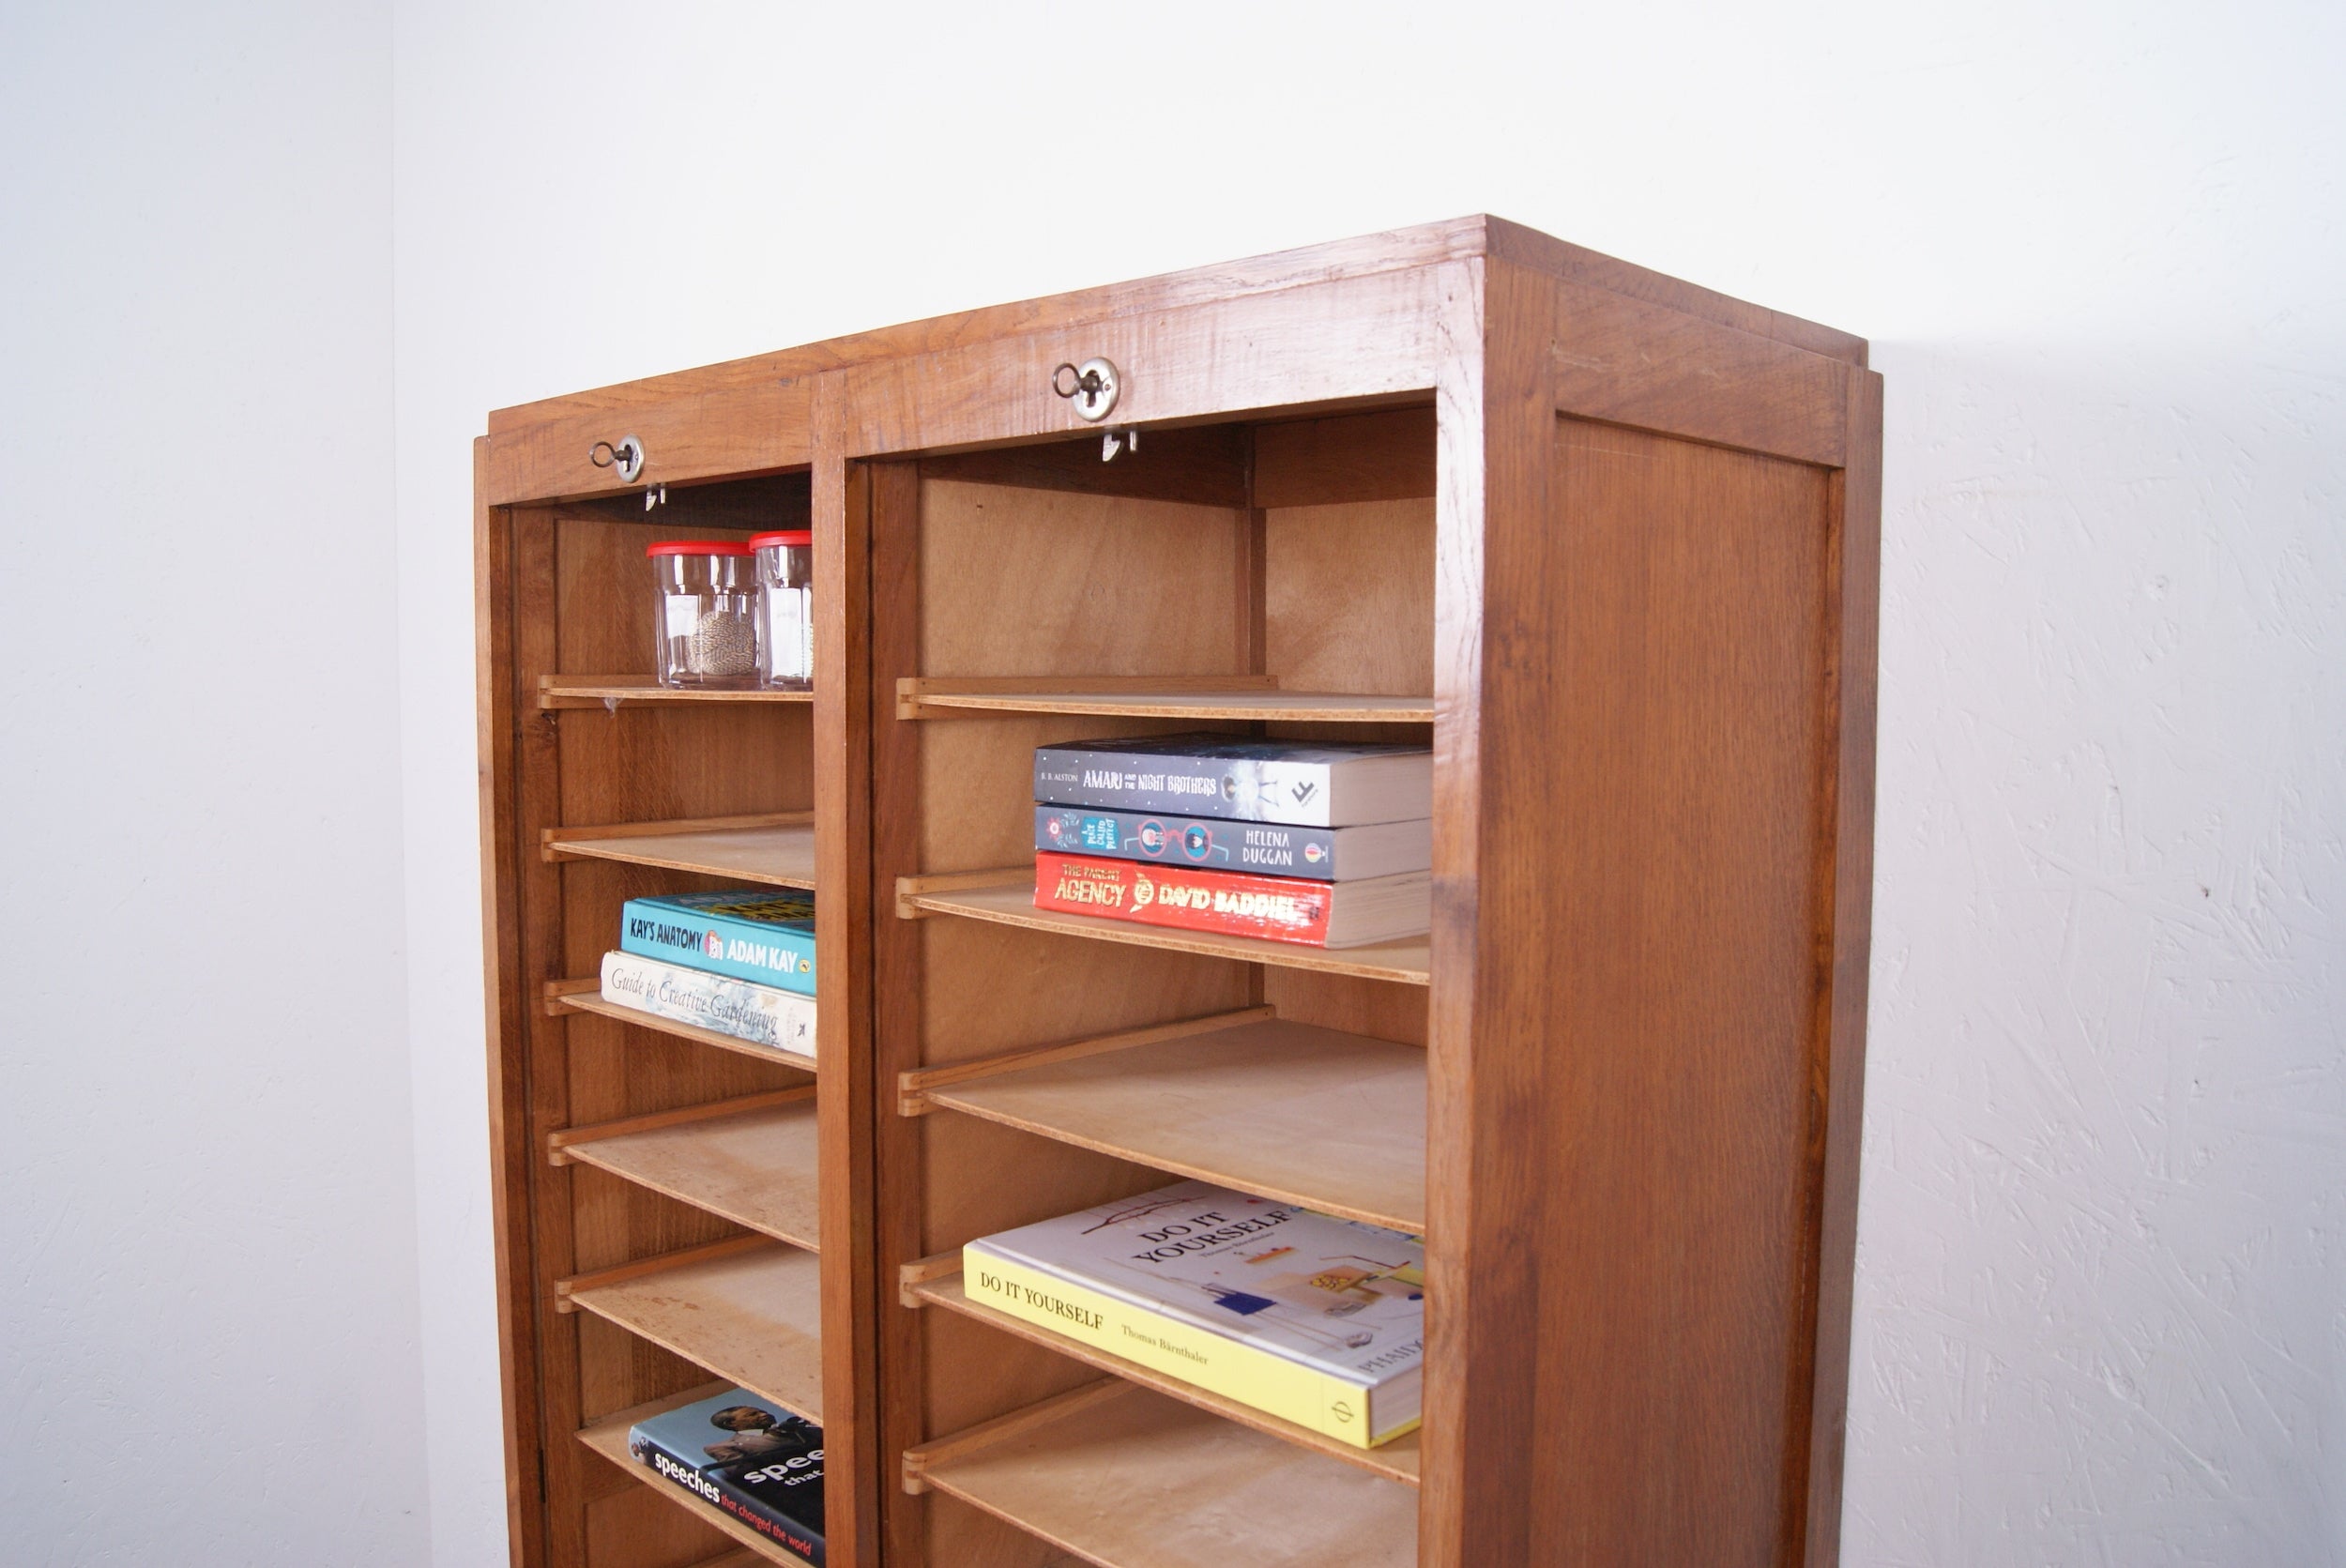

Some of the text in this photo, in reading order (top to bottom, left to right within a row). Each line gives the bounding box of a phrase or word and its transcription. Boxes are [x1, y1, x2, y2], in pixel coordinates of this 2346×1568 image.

[1054, 773, 1078, 782] ALSTON
[1083, 769, 1123, 790] AMARI
[1124, 773, 1136, 782] AND
[1137, 773, 1165, 791] NIGHT
[1167, 775, 1217, 797] BROTHERS
[1087, 824, 1096, 845] PLACE
[1096, 820, 1105, 845] CALLED
[1105, 818, 1117, 849] PERFECT
[1245, 830, 1289, 847] HELENA
[1242, 847, 1292, 866] DUGGAN
[1062, 863, 1121, 882] THE PARENT
[1054, 877, 1126, 908] AGENCY
[1158, 884, 1211, 910] DAVID
[1213, 891, 1296, 922] BADDIEL
[630, 917, 703, 952] KAY'S ANATOMY
[726, 938, 798, 974] ADAM KAY
[611, 967, 644, 996] Guide
[646, 979, 656, 998] to
[659, 981, 707, 1012] Creative
[710, 994, 780, 1045] Gardening
[1131, 1210, 1293, 1263] YOURSELF
[1137, 1211, 1227, 1243] DO IT
[980, 1271, 1104, 1331] DO IT YOURSELF
[1121, 1324, 1157, 1347] Thomas
[743, 1449, 824, 1484] spee
[784, 1469, 824, 1486] that
[655, 1453, 812, 1557] speeches that changed the world
